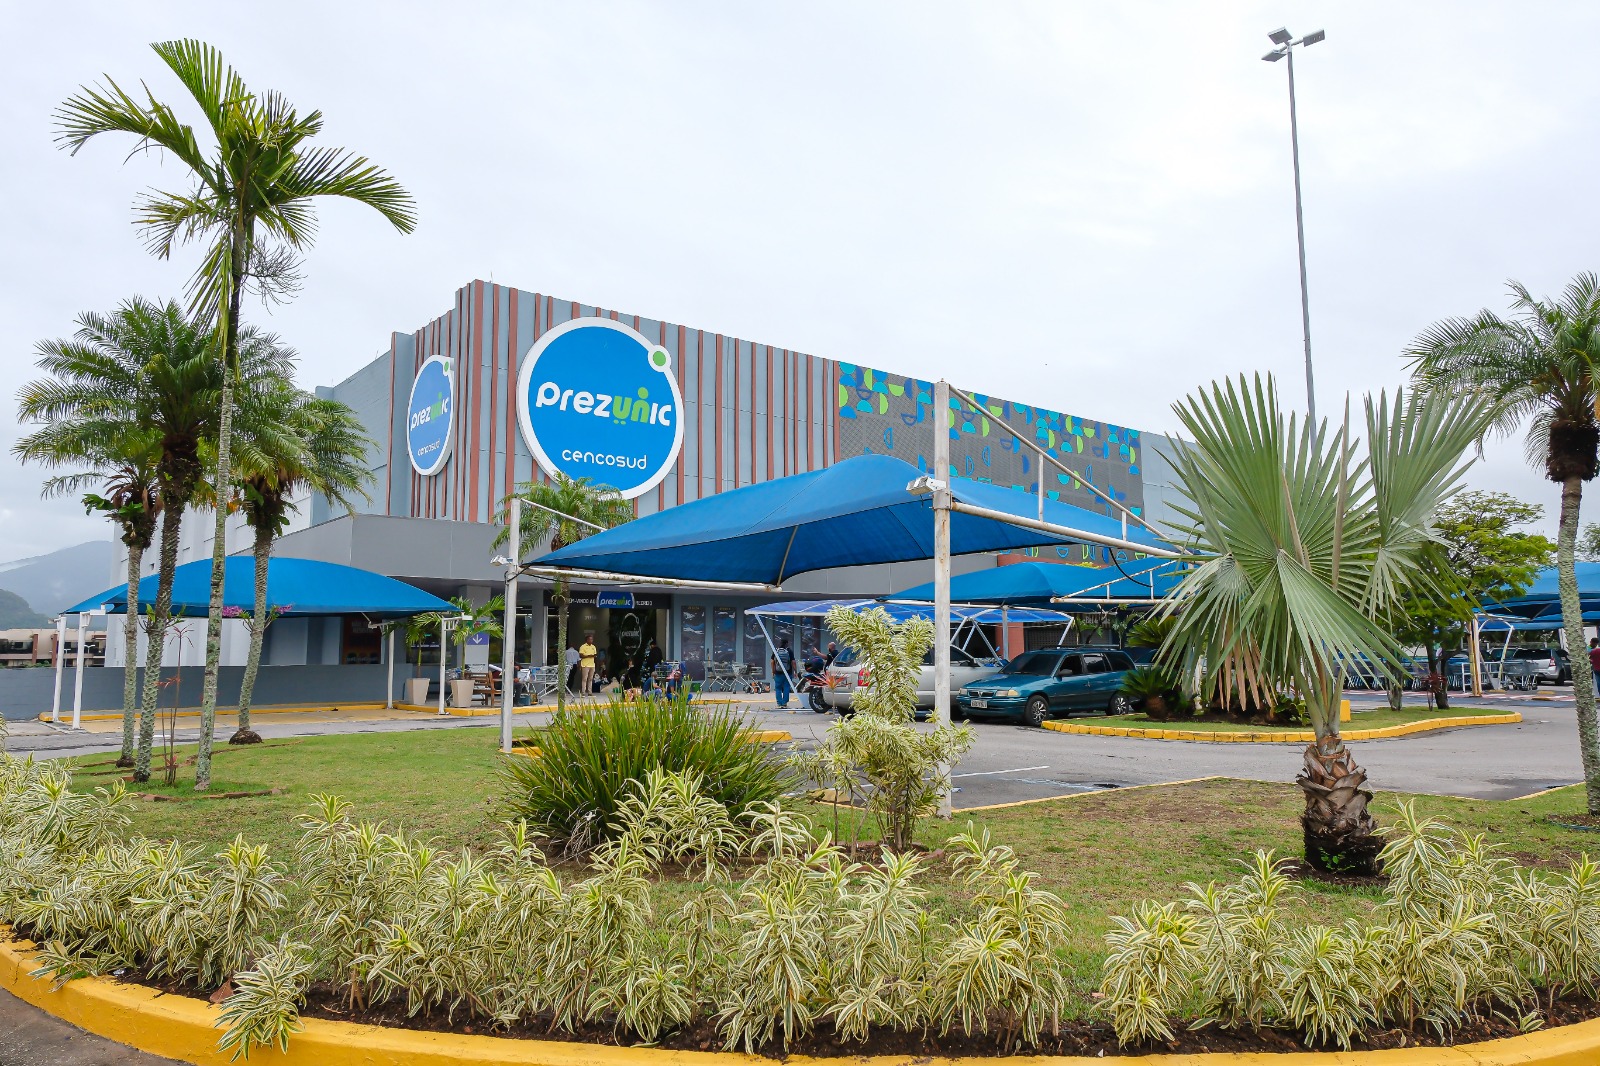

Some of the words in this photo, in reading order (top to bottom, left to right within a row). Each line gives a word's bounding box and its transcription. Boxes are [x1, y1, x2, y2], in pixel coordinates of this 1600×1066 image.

[410, 392, 449, 431] prezunic
[536, 381, 672, 427] prezunic
[561, 449, 647, 470] cencosud
